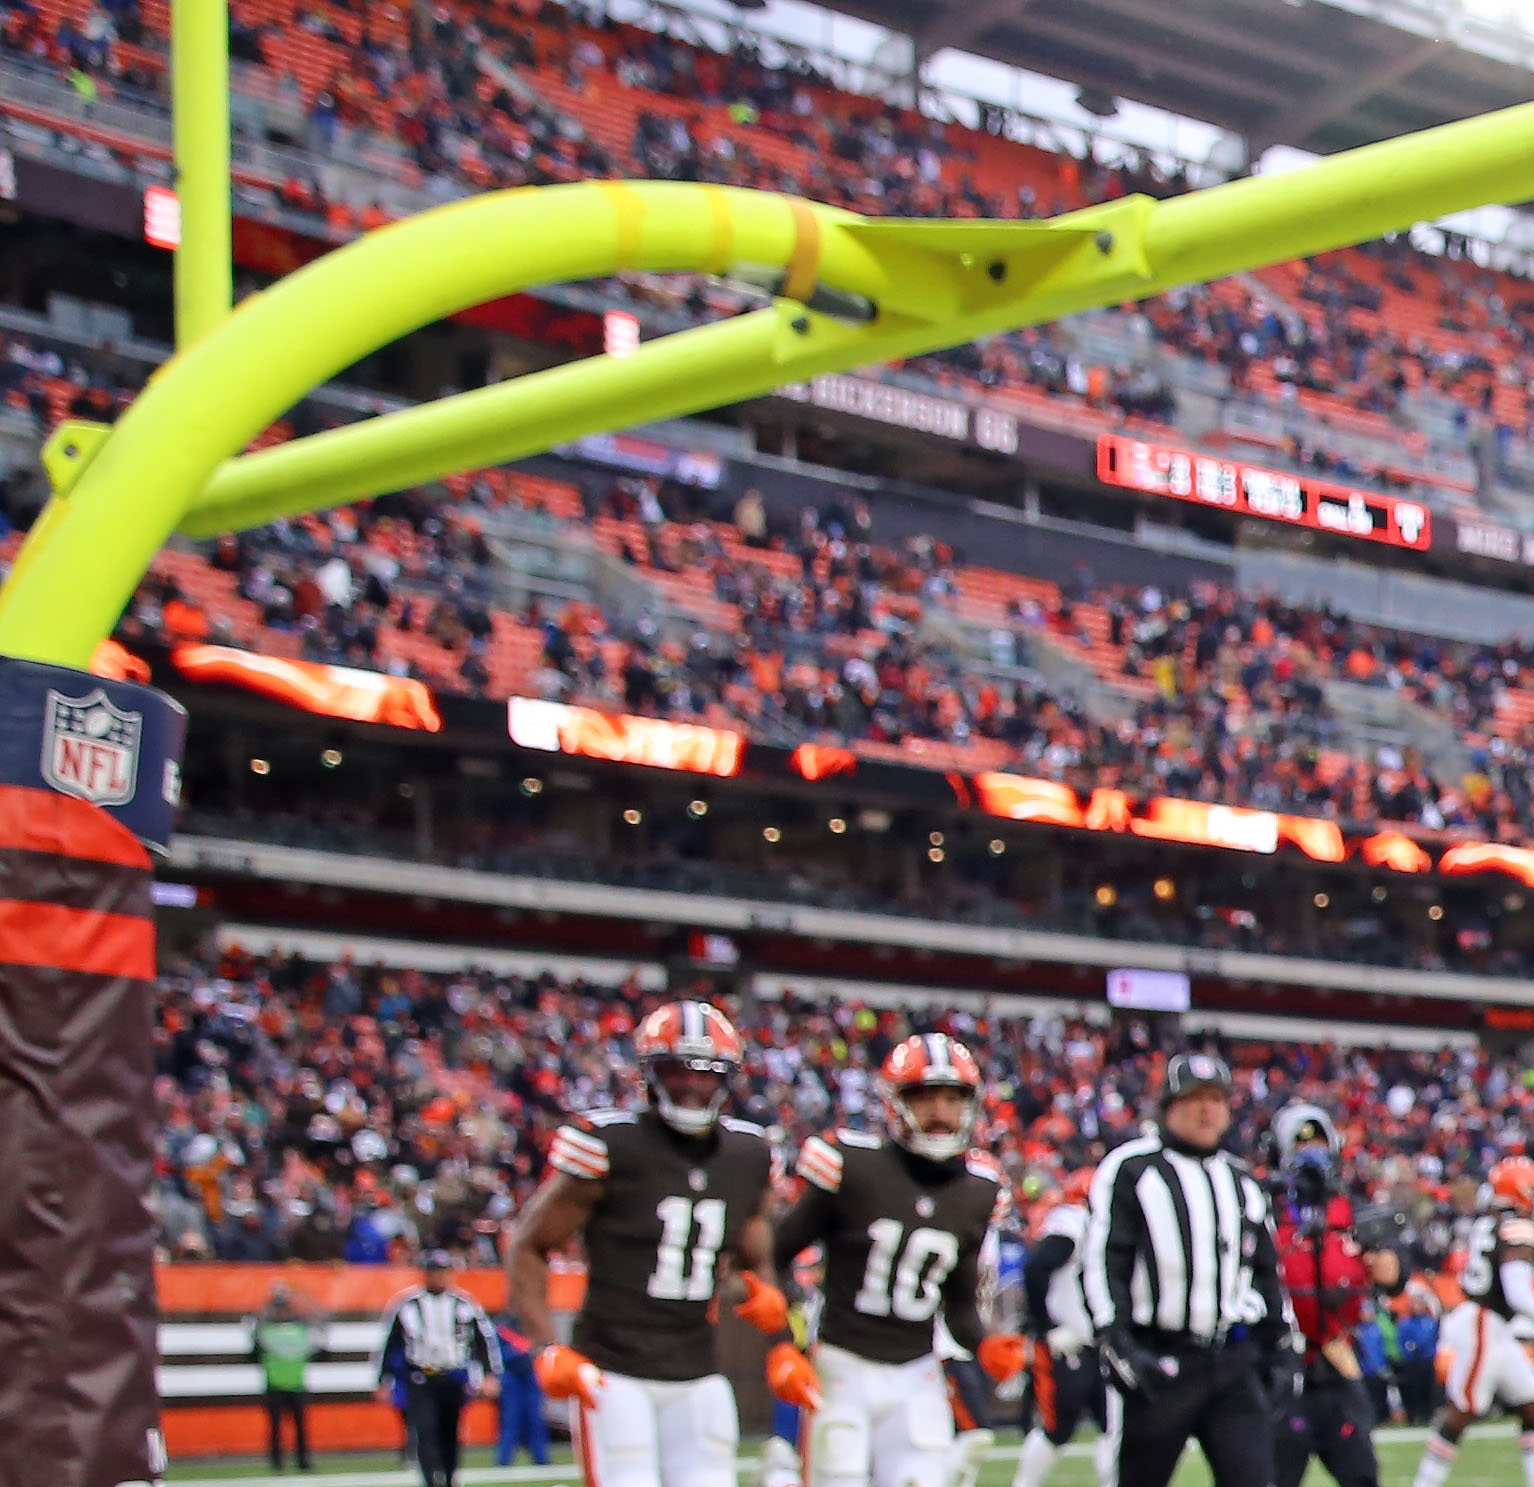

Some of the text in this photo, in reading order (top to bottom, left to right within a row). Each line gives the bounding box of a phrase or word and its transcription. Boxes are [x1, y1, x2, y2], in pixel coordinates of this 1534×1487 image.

[58, 736, 130, 791] NFL
[646, 1195, 727, 1301] 11
[854, 1217, 960, 1322] 10
